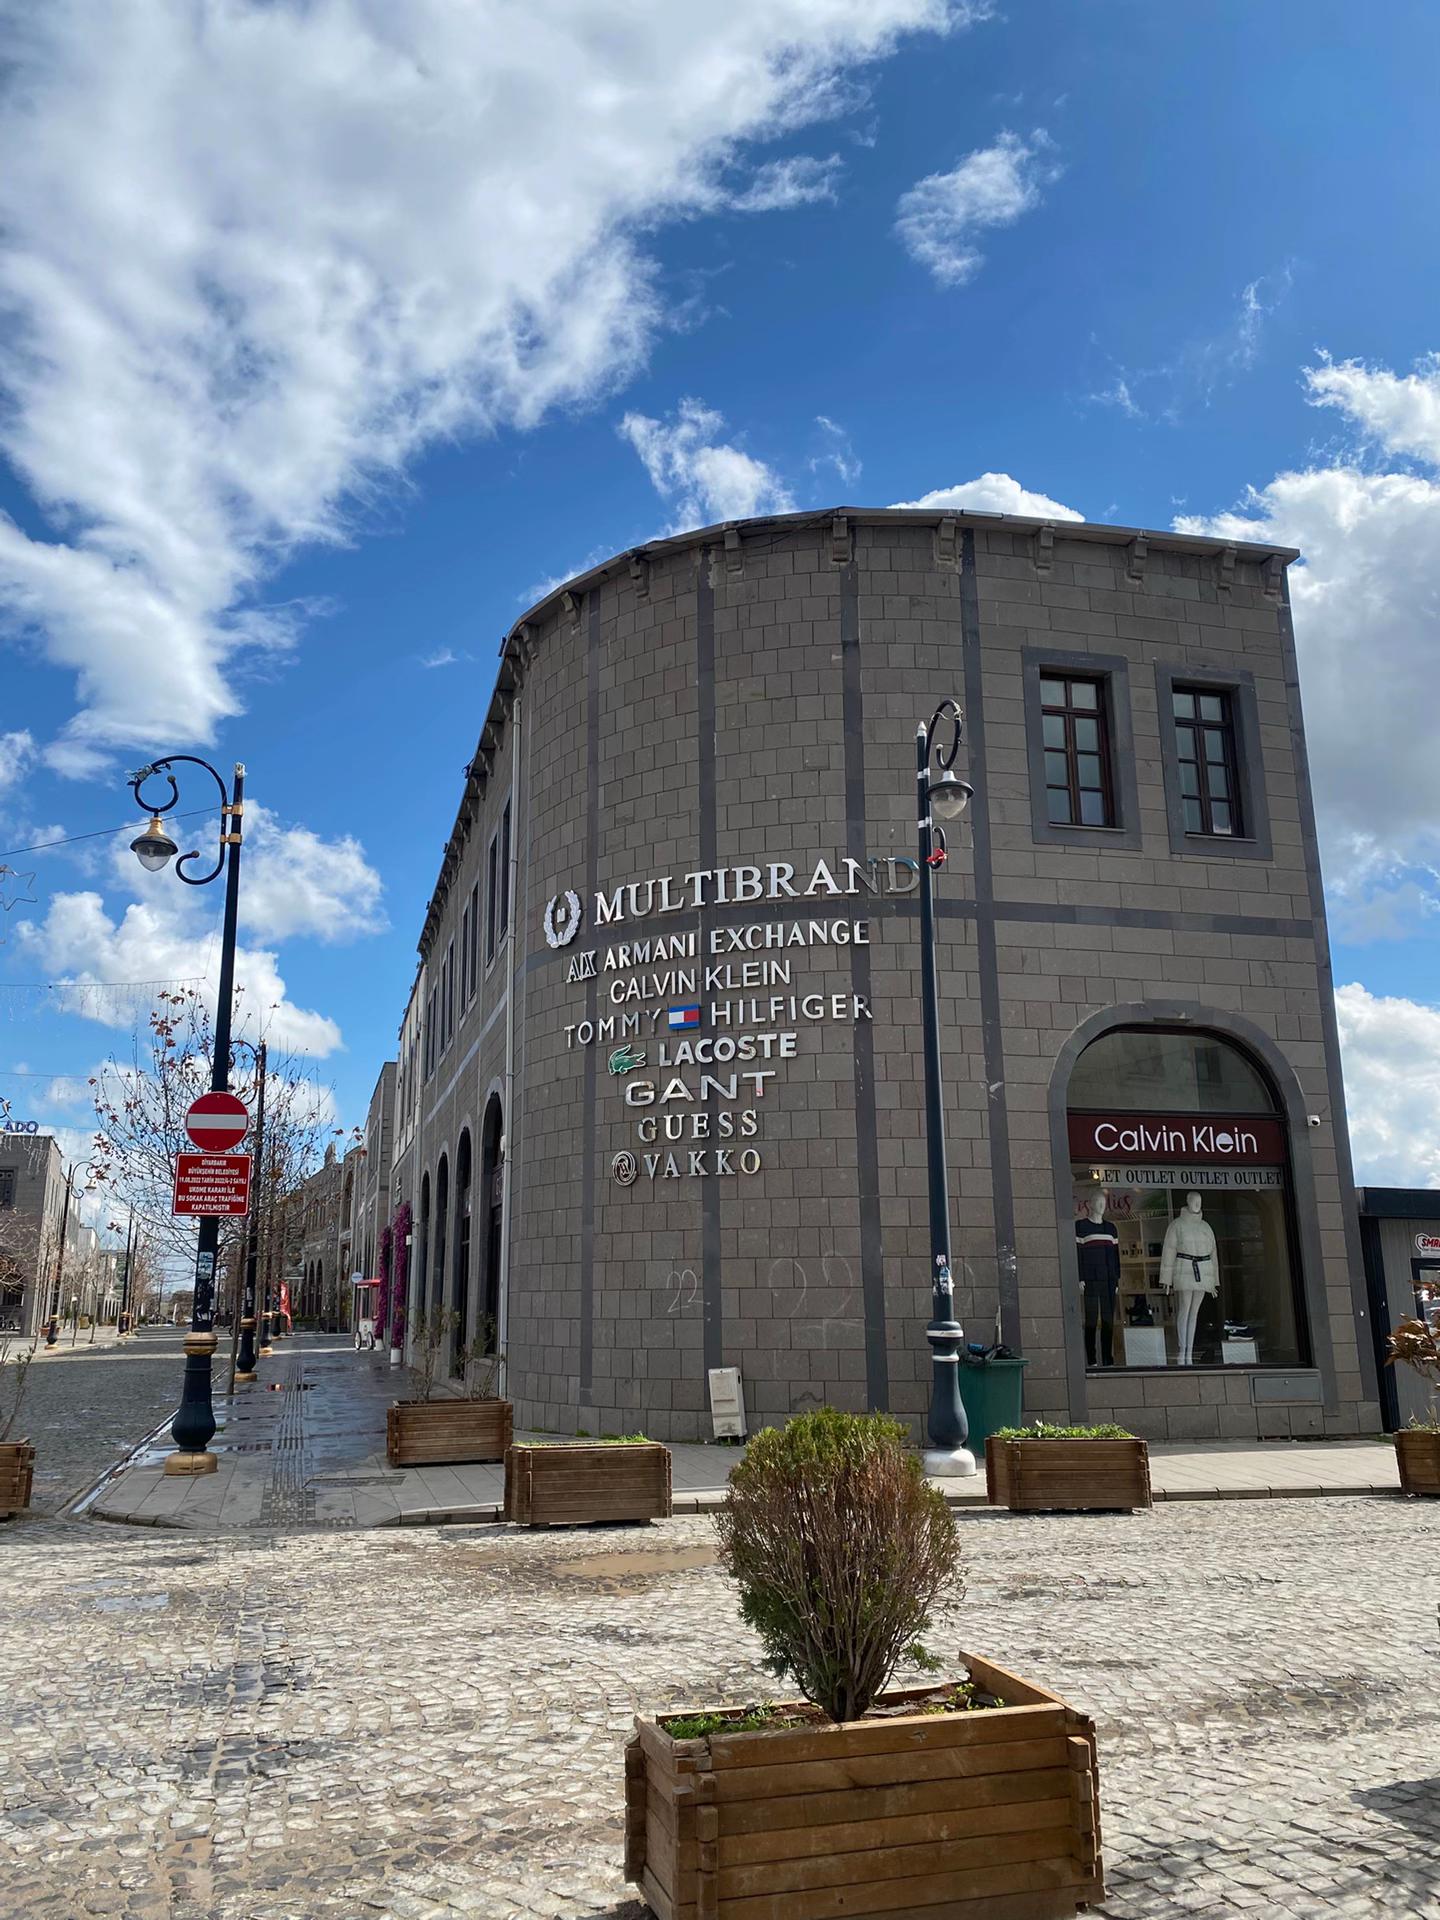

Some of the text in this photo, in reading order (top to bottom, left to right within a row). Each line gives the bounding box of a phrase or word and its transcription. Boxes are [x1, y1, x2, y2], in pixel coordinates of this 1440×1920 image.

[594, 856, 921, 926] MULTIBRAND
[603, 932, 696, 972] ARMANI
[709, 919, 871, 954] EXCHANGE
[609, 959, 791, 1004] CALVIN KLEIN
[563, 994, 874, 1049] TOMMY HILFIGER
[658, 1032, 798, 1068] LACOSTE
[625, 1070, 776, 1108] GANT
[637, 1109, 759, 1143] GUESS
[1094, 1123, 1258, 1153] Calvin Klein
[643, 1148, 762, 1181] VAKKO
[1126, 1169, 1176, 1185] OUTLET
[1180, 1170, 1230, 1185] OUTLET
[1234, 1171, 1282, 1186] OUTLET
[186, 1194, 204, 1202] SOKAK
[204, 1195, 218, 1203] ARAÇ
